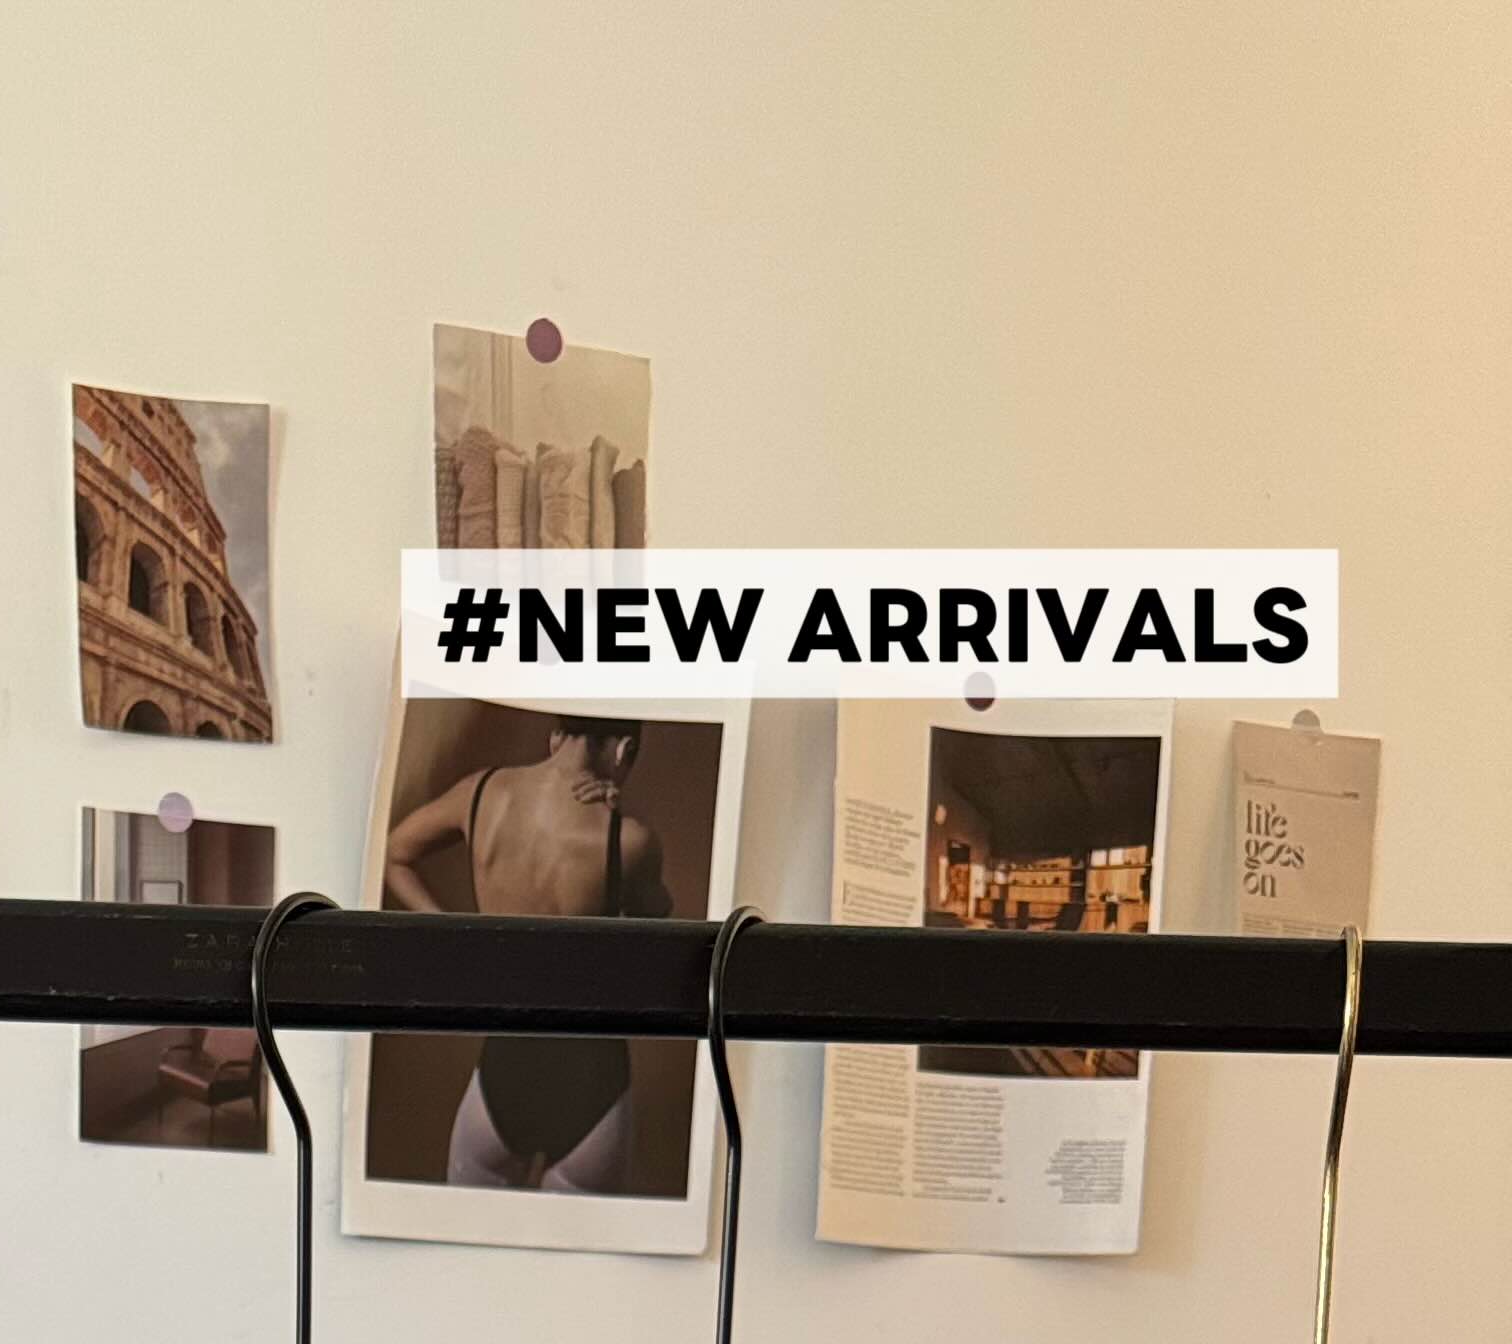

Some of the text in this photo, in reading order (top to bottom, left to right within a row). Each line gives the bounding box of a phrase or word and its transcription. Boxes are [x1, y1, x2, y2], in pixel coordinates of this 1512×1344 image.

[1247, 800, 1287, 838] life
[1245, 839, 1304, 869] goes
[1243, 872, 1276, 897] on
